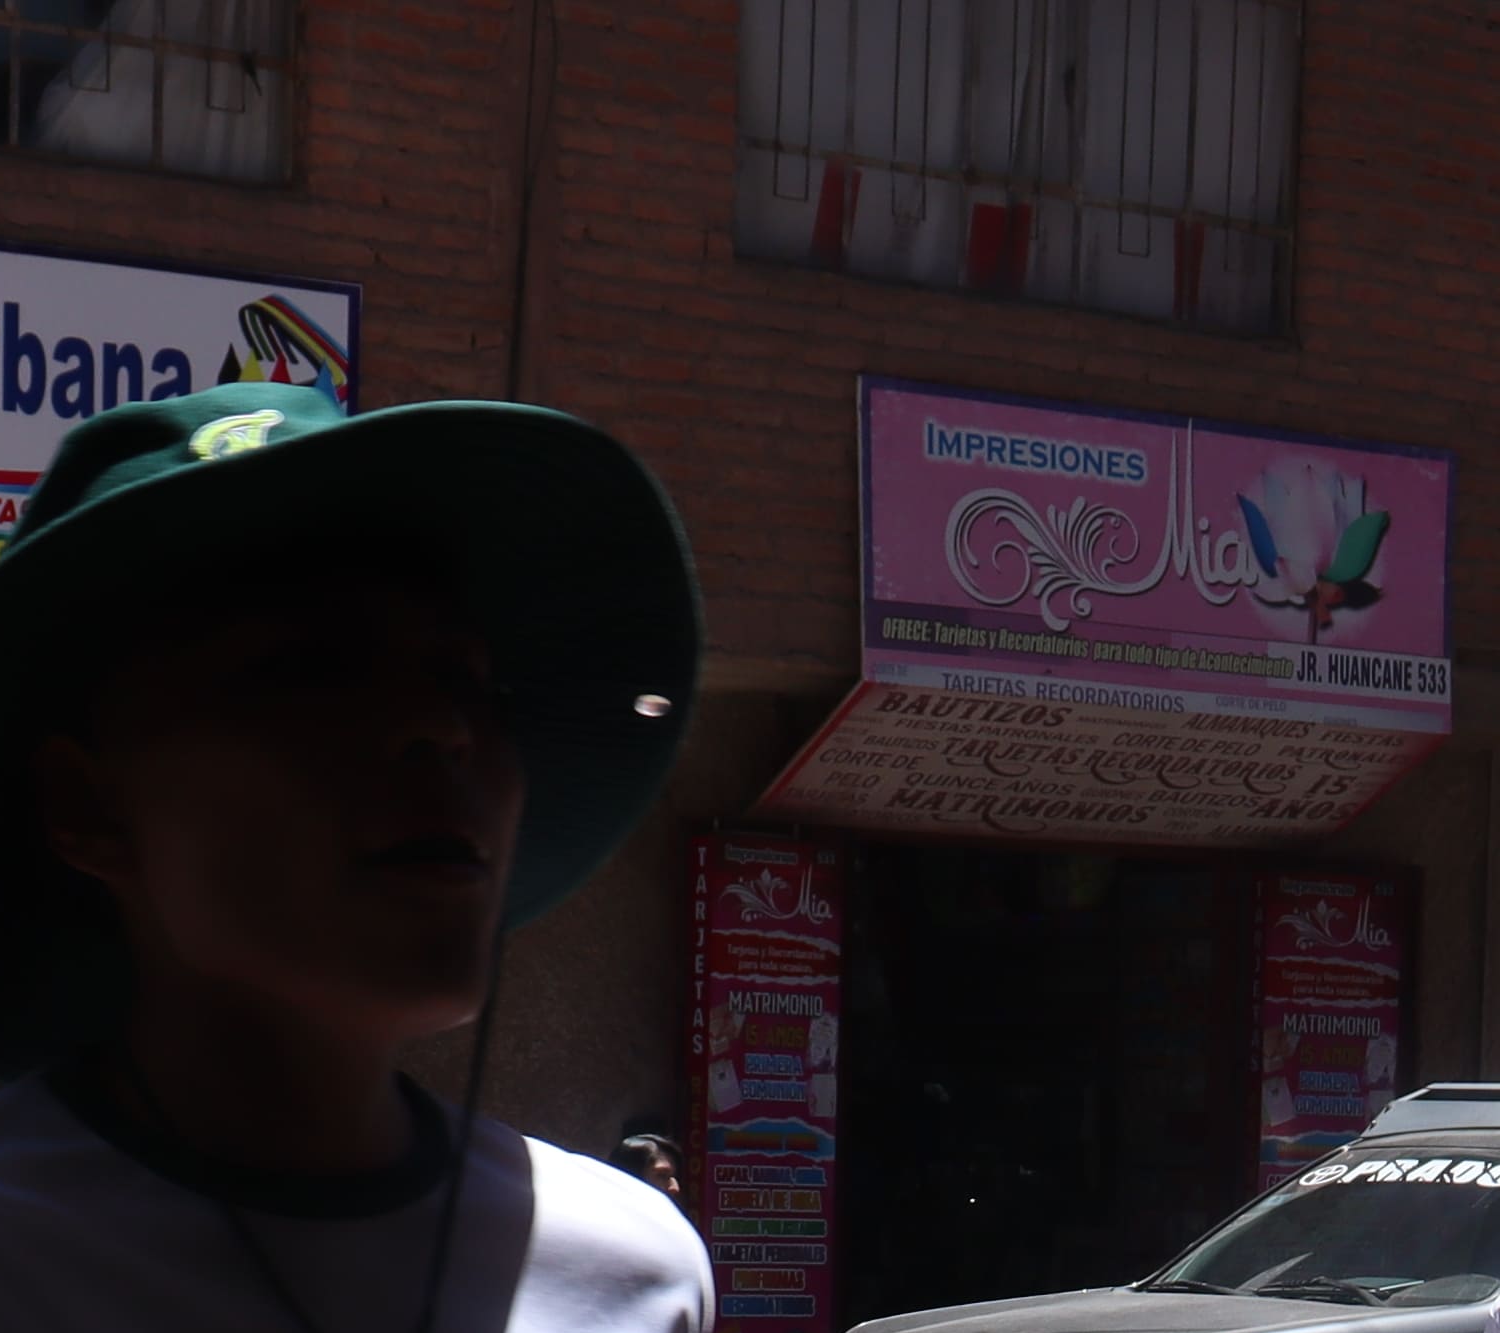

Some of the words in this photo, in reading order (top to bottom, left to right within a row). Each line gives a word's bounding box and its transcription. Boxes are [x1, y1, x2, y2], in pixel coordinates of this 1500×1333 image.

[926, 423, 1145, 481] IMPRESIONES
[934, 621, 987, 648] Tarjetas
[998, 627, 1089, 658] Recordatorios
[1297, 651, 1323, 684] JR.
[1328, 656, 1413, 692] HUANCANE
[1417, 664, 1447, 696] 533
[942, 672, 1027, 699] TARJETAS
[1036, 682, 1185, 713] RECORDATORIOS
[876, 692, 1073, 727] BAUTIZOS
[894, 718, 974, 736] FIESTAS
[976, 724, 1100, 746] PATRONALES
[1112, 732, 1181, 751] CORTE
[1210, 741, 1262, 757] PELO
[818, 750, 887, 768] CORTE
[823, 772, 881, 789] PELO
[904, 771, 999, 792] QUINCE
[728, 990, 824, 1017] MATRIMONIO
[1282, 1012, 1381, 1037] MATRIMONIO
